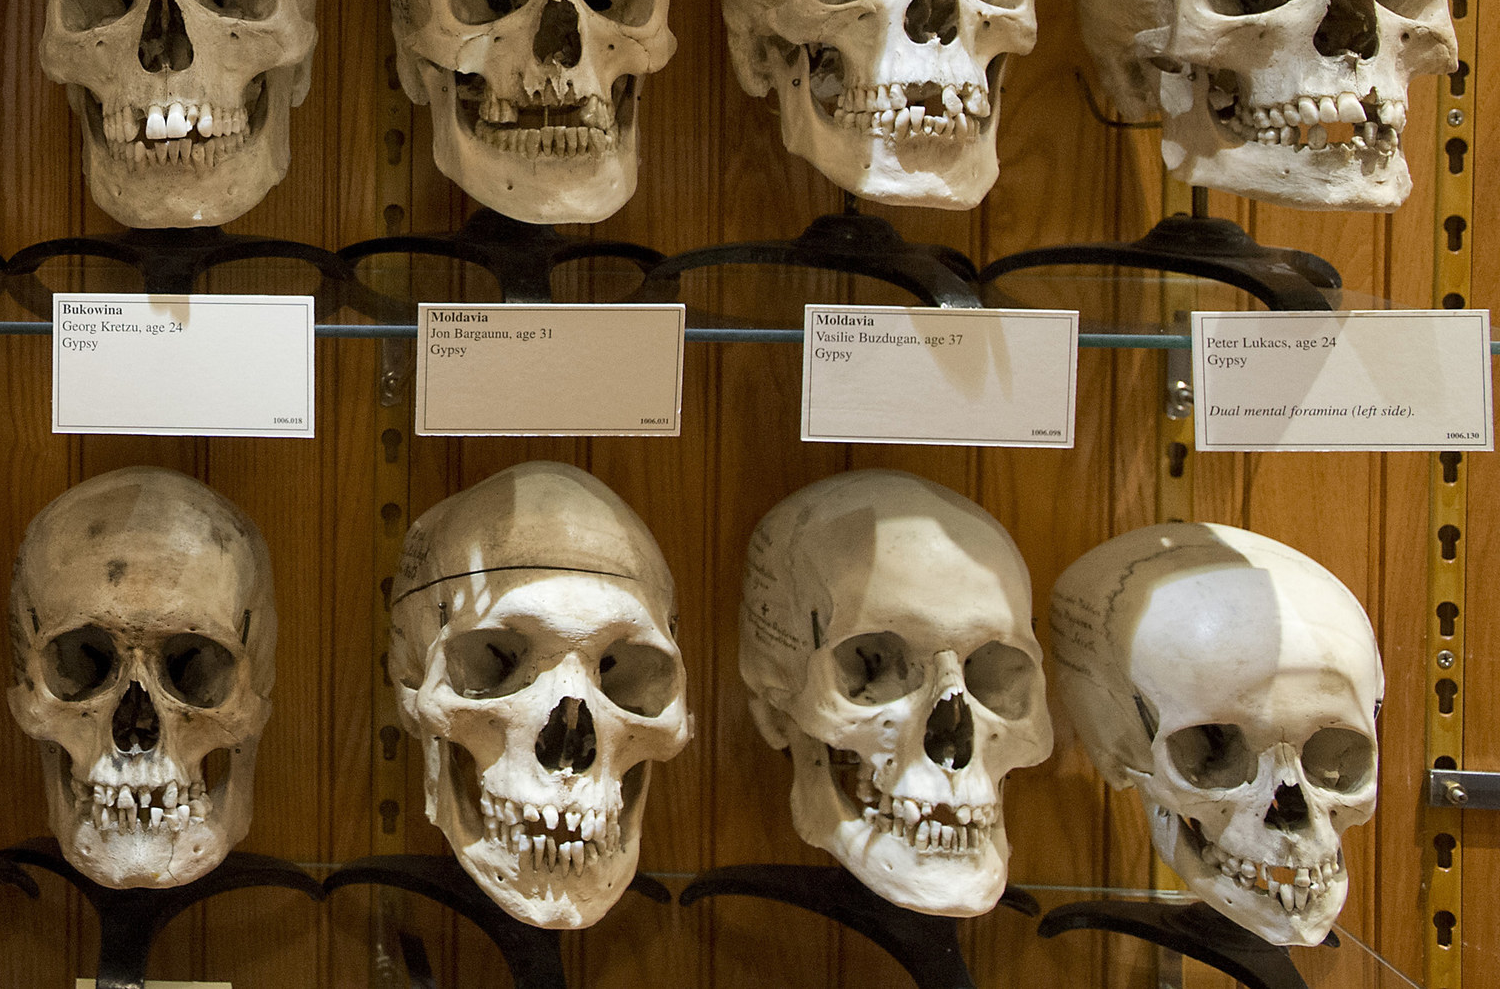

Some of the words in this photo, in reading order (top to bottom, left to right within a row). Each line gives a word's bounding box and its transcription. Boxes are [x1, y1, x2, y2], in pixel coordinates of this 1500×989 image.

[62, 303, 122, 315] Bukowina
[431, 311, 488, 323] Moldavia
[816, 314, 874, 326] Moldavia
[61, 320, 96, 335] Georg
[100, 320, 142, 333] Kretzu,
[145, 324, 165, 335] age
[168, 321, 183, 333] 24
[429, 328, 450, 339] Jon
[453, 328, 512, 342] Bargaunu,
[515, 330, 536, 342] age
[539, 328, 552, 339] 31
[815, 330, 855, 343] Vasilie
[858, 331, 920, 347] Buzdugan,
[924, 336, 945, 348] age
[948, 333, 963, 345] 37
[61, 337, 98, 351] Gypsy
[1206, 336, 1239, 348] Peter
[1242, 336, 1291, 349] Lukacs,
[1294, 339, 1317, 350] age
[1321, 336, 1336, 348] 24
[429, 344, 467, 358] Gypsy
[814, 347, 852, 362] Gypsy
[1206, 353, 1247, 369] Gypsy
